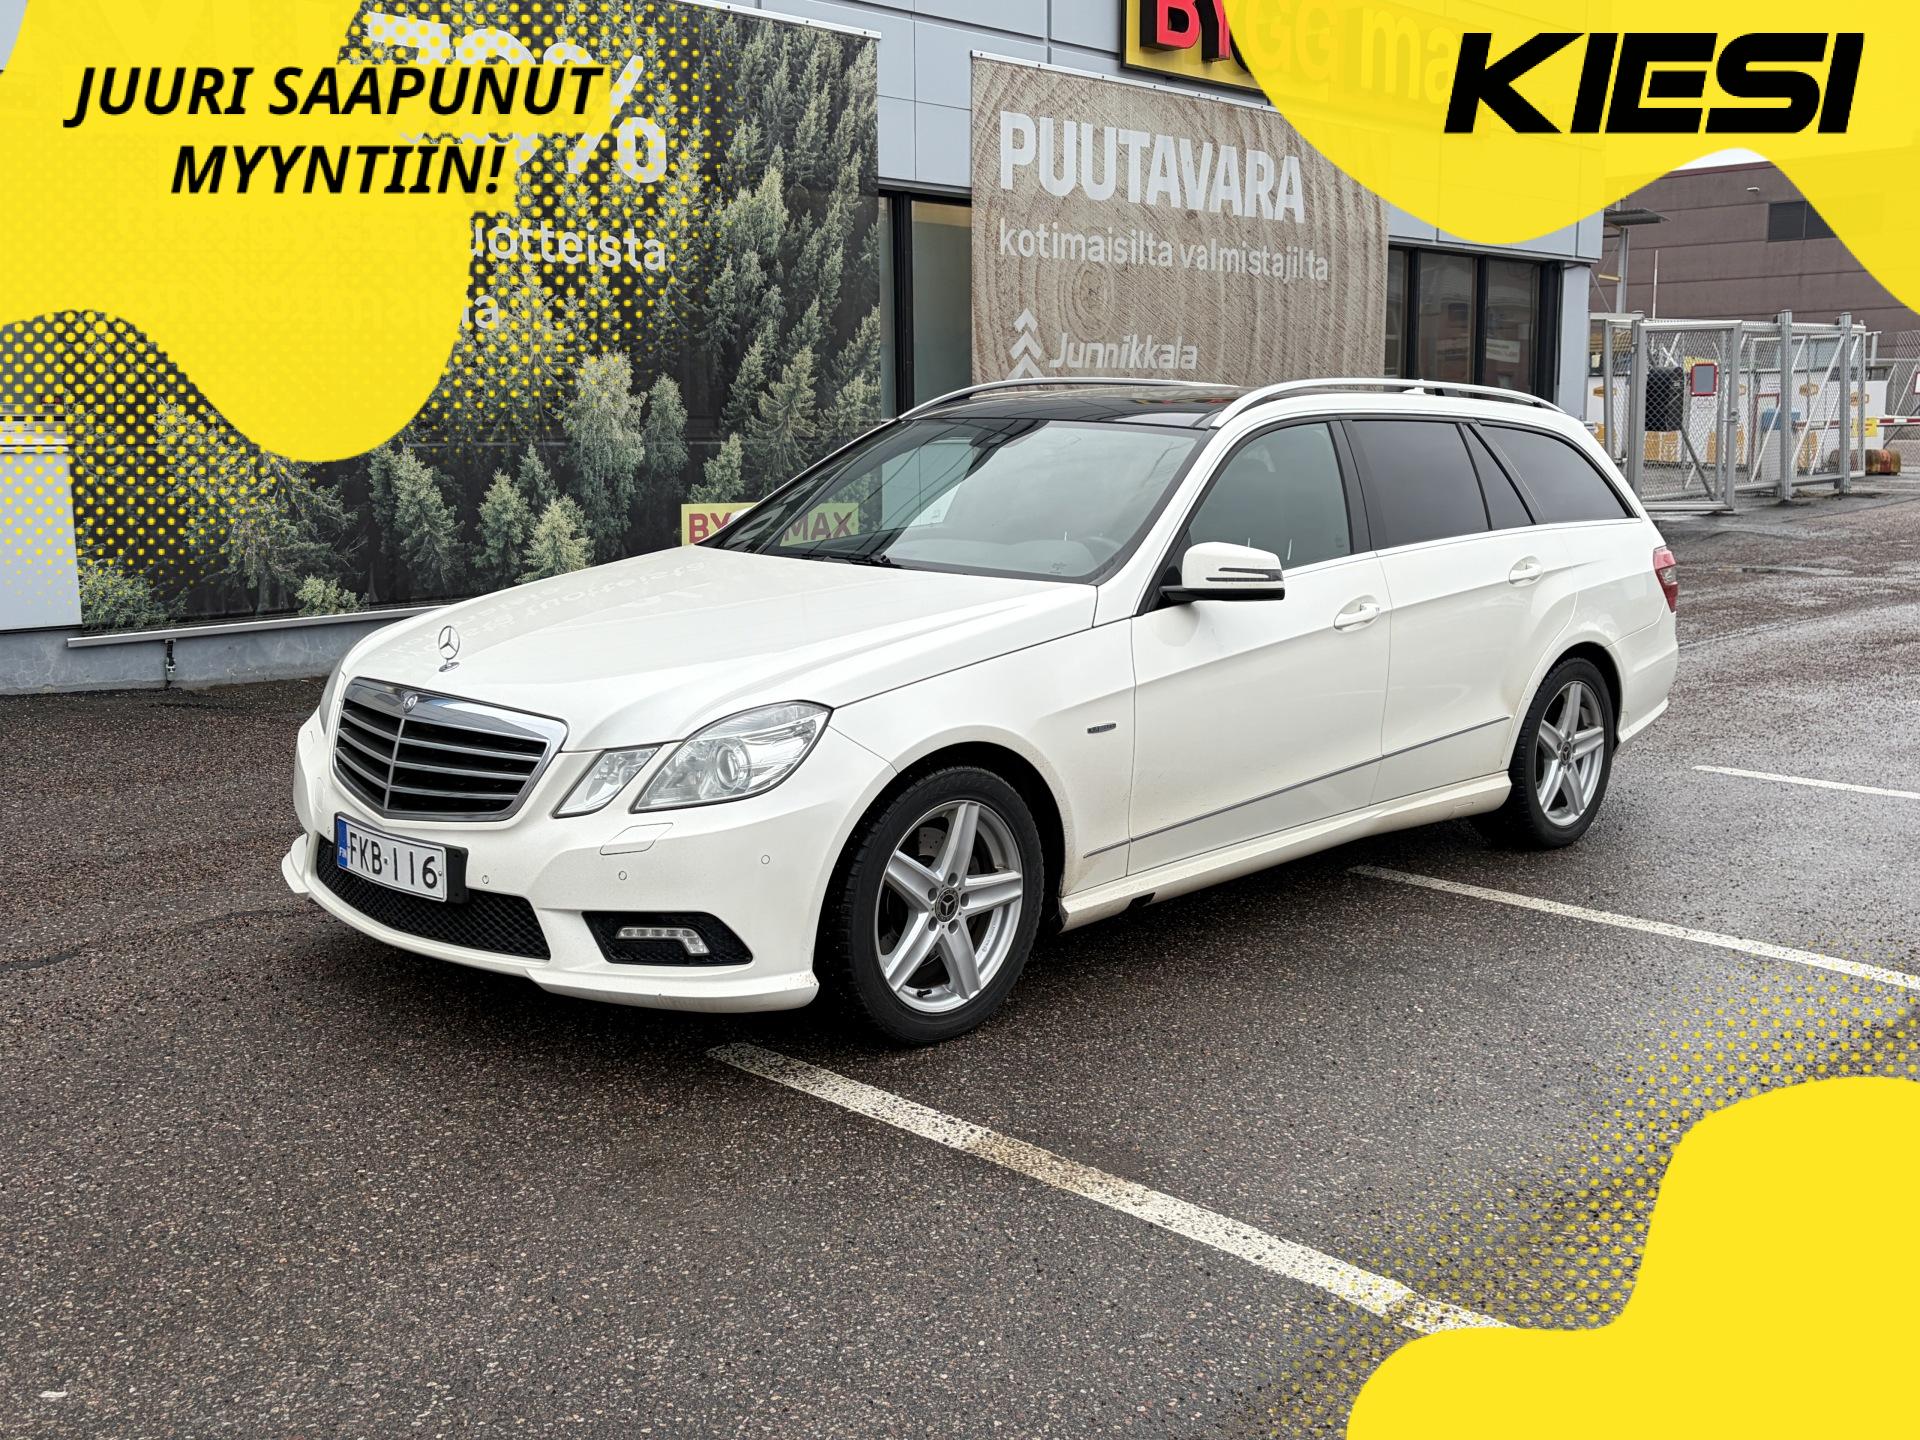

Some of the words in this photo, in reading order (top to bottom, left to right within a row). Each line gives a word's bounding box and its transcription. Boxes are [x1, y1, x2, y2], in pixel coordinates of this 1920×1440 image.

[1000, 110, 1305, 224] PUUTAVARA
[1000, 217, 1173, 268] kotimaisilta
[1181, 238, 1328, 283] valmistajilta
[1049, 332, 1198, 370] Junnikkala
[350, 831, 437, 889] FKB-116
